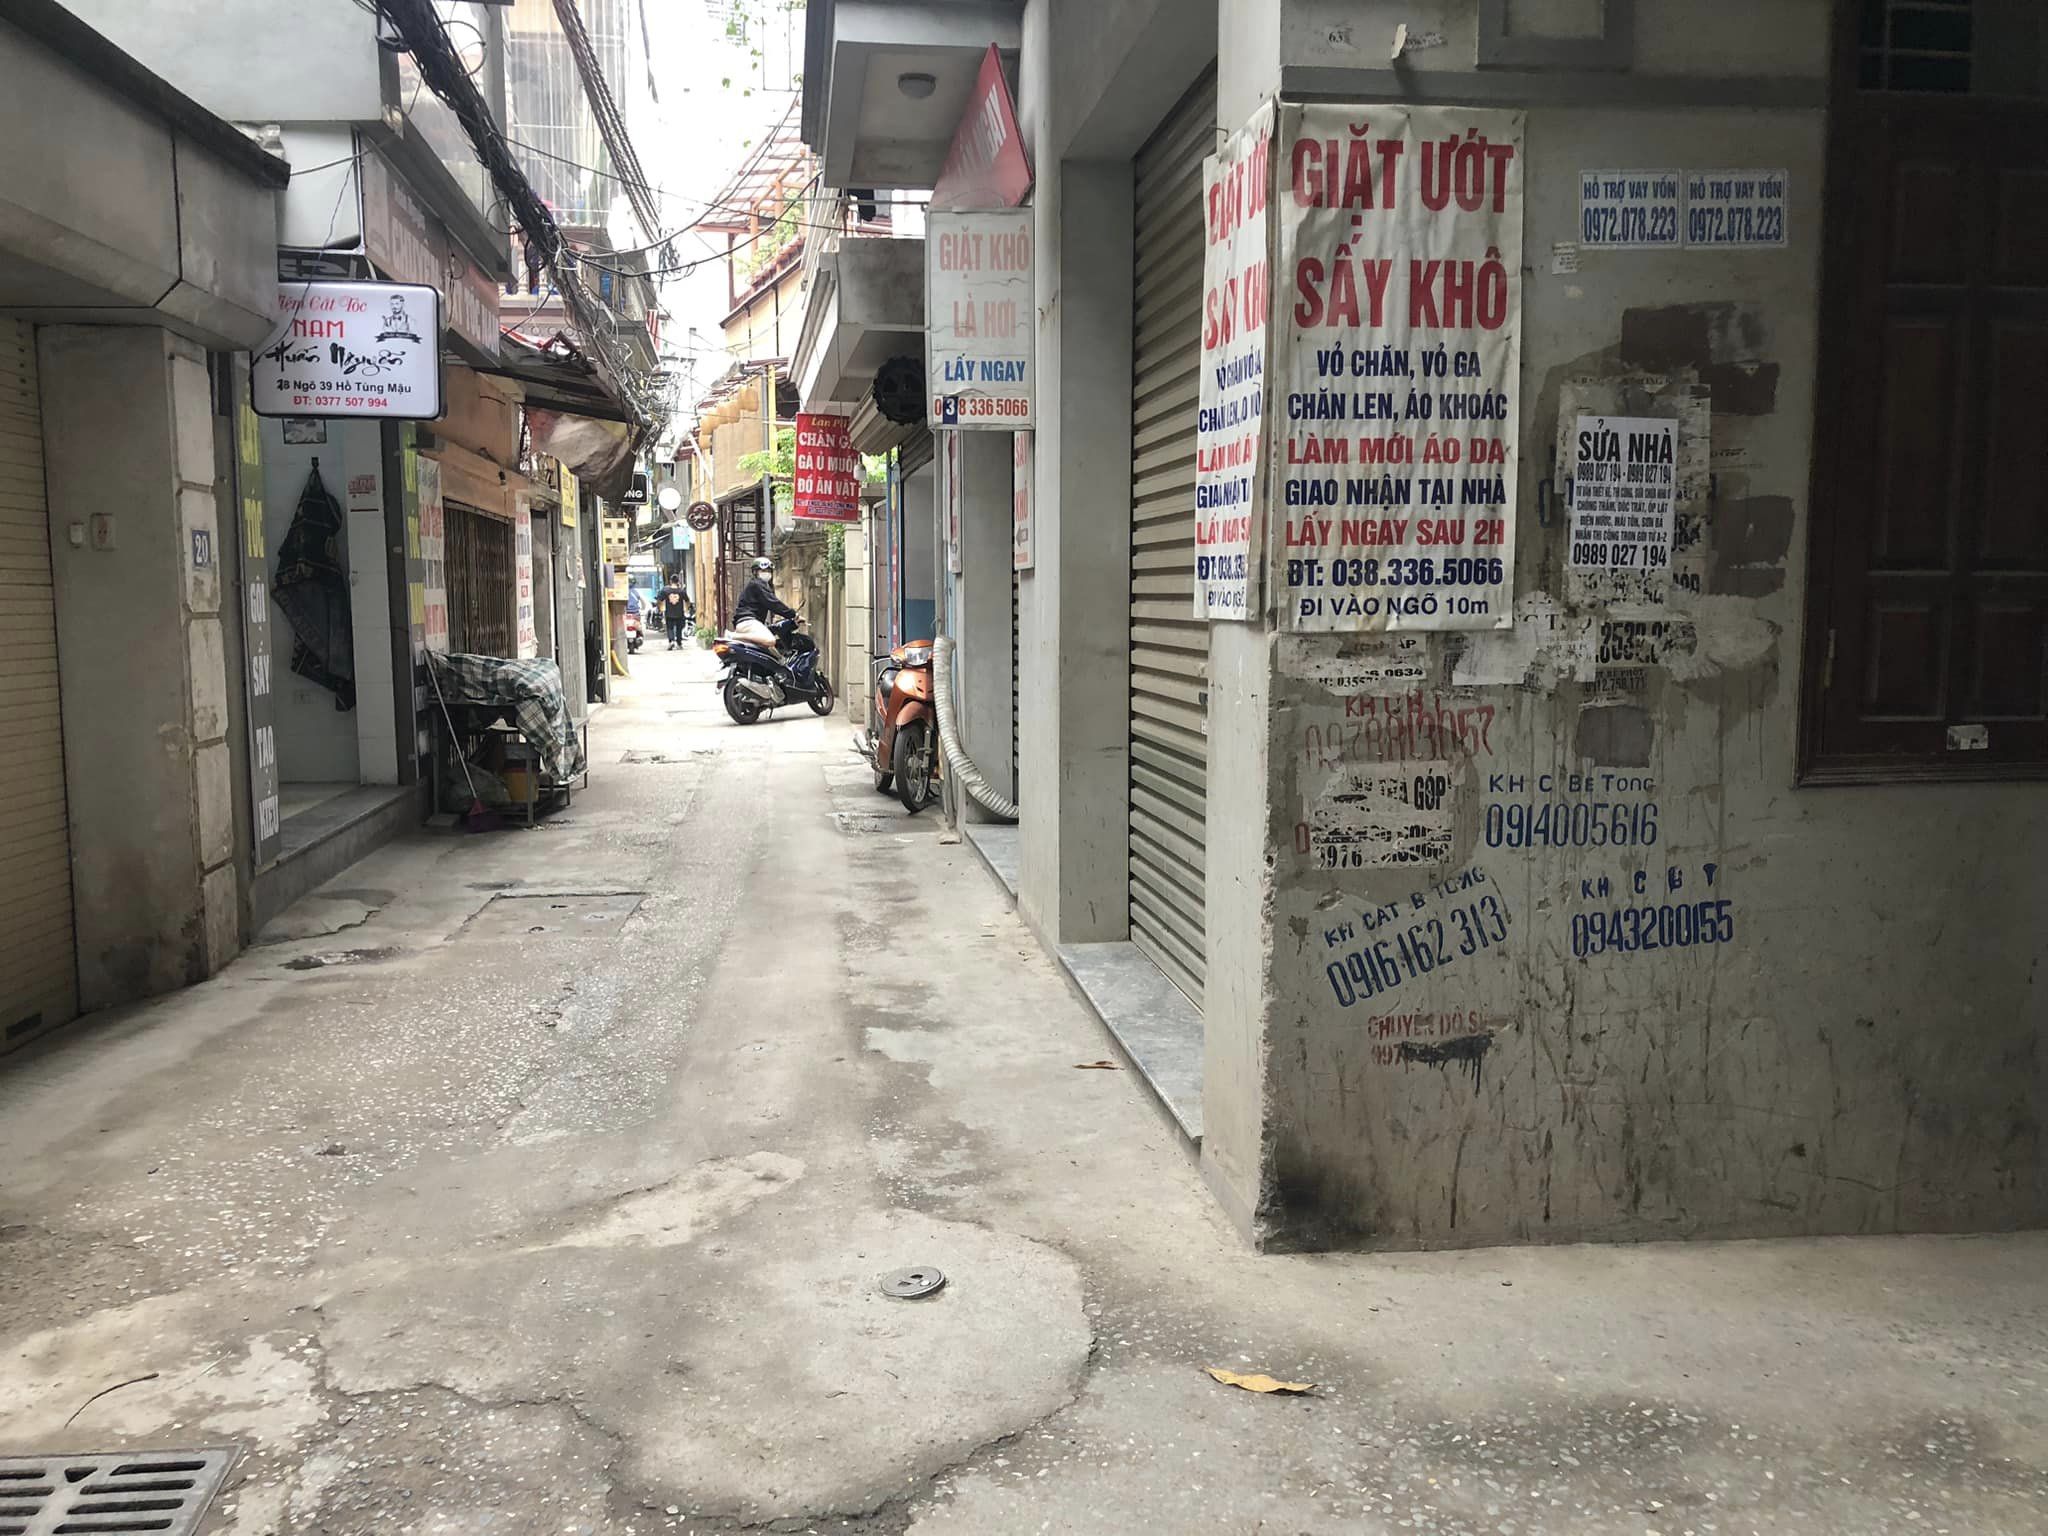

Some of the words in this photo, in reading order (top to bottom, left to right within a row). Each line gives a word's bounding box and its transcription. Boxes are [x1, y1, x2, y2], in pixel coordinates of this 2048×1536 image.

[1292, 122, 1404, 226] GIẶT
[1421, 127, 1514, 213] ƯỚT
[1604, 178, 1626, 204] TRỢ
[1629, 180, 1648, 199] VAY
[1653, 175, 1676, 200] VỐN
[1710, 178, 1732, 204] TRỢ
[1735, 181, 1754, 199] VAY
[1759, 175, 1782, 200] VỐN
[1584, 206, 1676, 242] 0972.078.223
[1689, 206, 1781, 242] 0972.078.223
[939, 225, 983, 280] GIẶT
[989, 225, 1030, 272] KHÔ
[1294, 233, 1392, 329] SẤY
[1409, 245, 1507, 330] KHÔ
[293, 319, 344, 339] NAM
[944, 352, 976, 382] LẤY
[981, 360, 1026, 382] NGAY
[1316, 341, 1344, 377] VỎ
[1351, 343, 1416, 380] CHĂN,
[1421, 341, 1447, 377] VỎ
[1454, 349, 1482, 378] GA
[293, 396, 312, 407] ĐT:
[315, 396, 343, 407] 0377
[346, 396, 364, 407] 507
[368, 397, 388, 408] 994
[319, 381, 333, 392] 39
[356, 380, 384, 394] Tùng
[388, 382, 412, 396] Mậu
[970, 399, 993, 417] 336
[996, 399, 1028, 417] 5066
[1288, 387, 1346, 421] CHĂN
[1353, 392, 1399, 424] LEN,
[1405, 387, 1432, 421] ÁO
[1439, 387, 1508, 421] KHOÁC
[1288, 432, 1348, 464] LÀM
[1359, 432, 1413, 464] MỚI
[1422, 432, 1461, 464] ÁO
[1470, 437, 1505, 464] DA
[1578, 418, 1621, 463] SỬA
[1628, 428, 1673, 464] NHÀ
[1577, 462, 1594, 482] 0989
[1595, 463, 1607, 482] 027
[1609, 463, 1621, 483] 194
[1645, 464, 1658, 483] 027
[1660, 464, 1672, 483] 194
[1285, 478, 1339, 506] GIAO
[1346, 474, 1411, 511] NHẬN
[1418, 478, 1454, 511] TẠI
[1461, 473, 1507, 505] NHÀ
[1286, 511, 1332, 546] LẤY
[1341, 518, 1408, 547] NGAY
[1416, 518, 1465, 546] SAU
[1474, 518, 1505, 546] 2H
[1573, 542, 1607, 566] 0989
[1611, 543, 1638, 566] 027
[1642, 545, 1667, 567] 194
[1288, 558, 1324, 587] ĐT:
[1332, 557, 1503, 587] 038.336.5066
[1301, 597, 1322, 616] ĐI
[1330, 589, 1379, 616] VÀO
[1386, 588, 1438, 616] NGÕ
[1446, 597, 1489, 615] 10m
[1539, 775, 1553, 793] C
[1485, 802, 1658, 848] 0914005616
[1634, 870, 1647, 894] C
[1362, 902, 1399, 931] CAT
[1572, 900, 1734, 958] 0943200155
